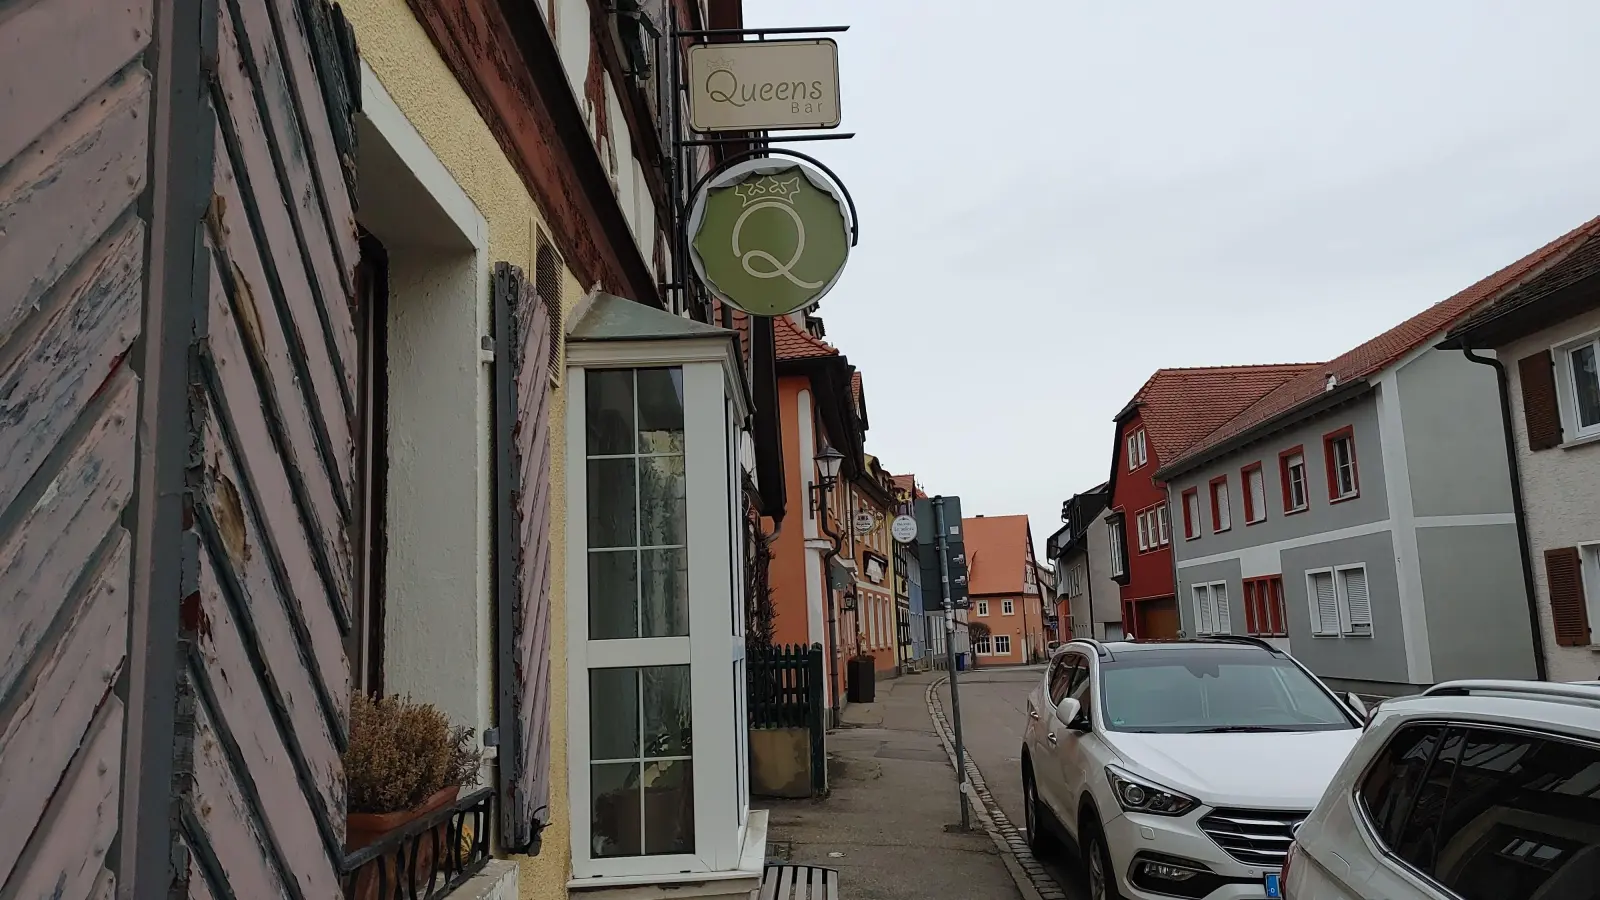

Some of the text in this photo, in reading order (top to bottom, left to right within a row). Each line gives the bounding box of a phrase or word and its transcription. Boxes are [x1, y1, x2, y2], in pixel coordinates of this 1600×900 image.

[705, 69, 822, 107] Queens
[791, 102, 823, 114] Bar
[731, 201, 824, 289] Q
